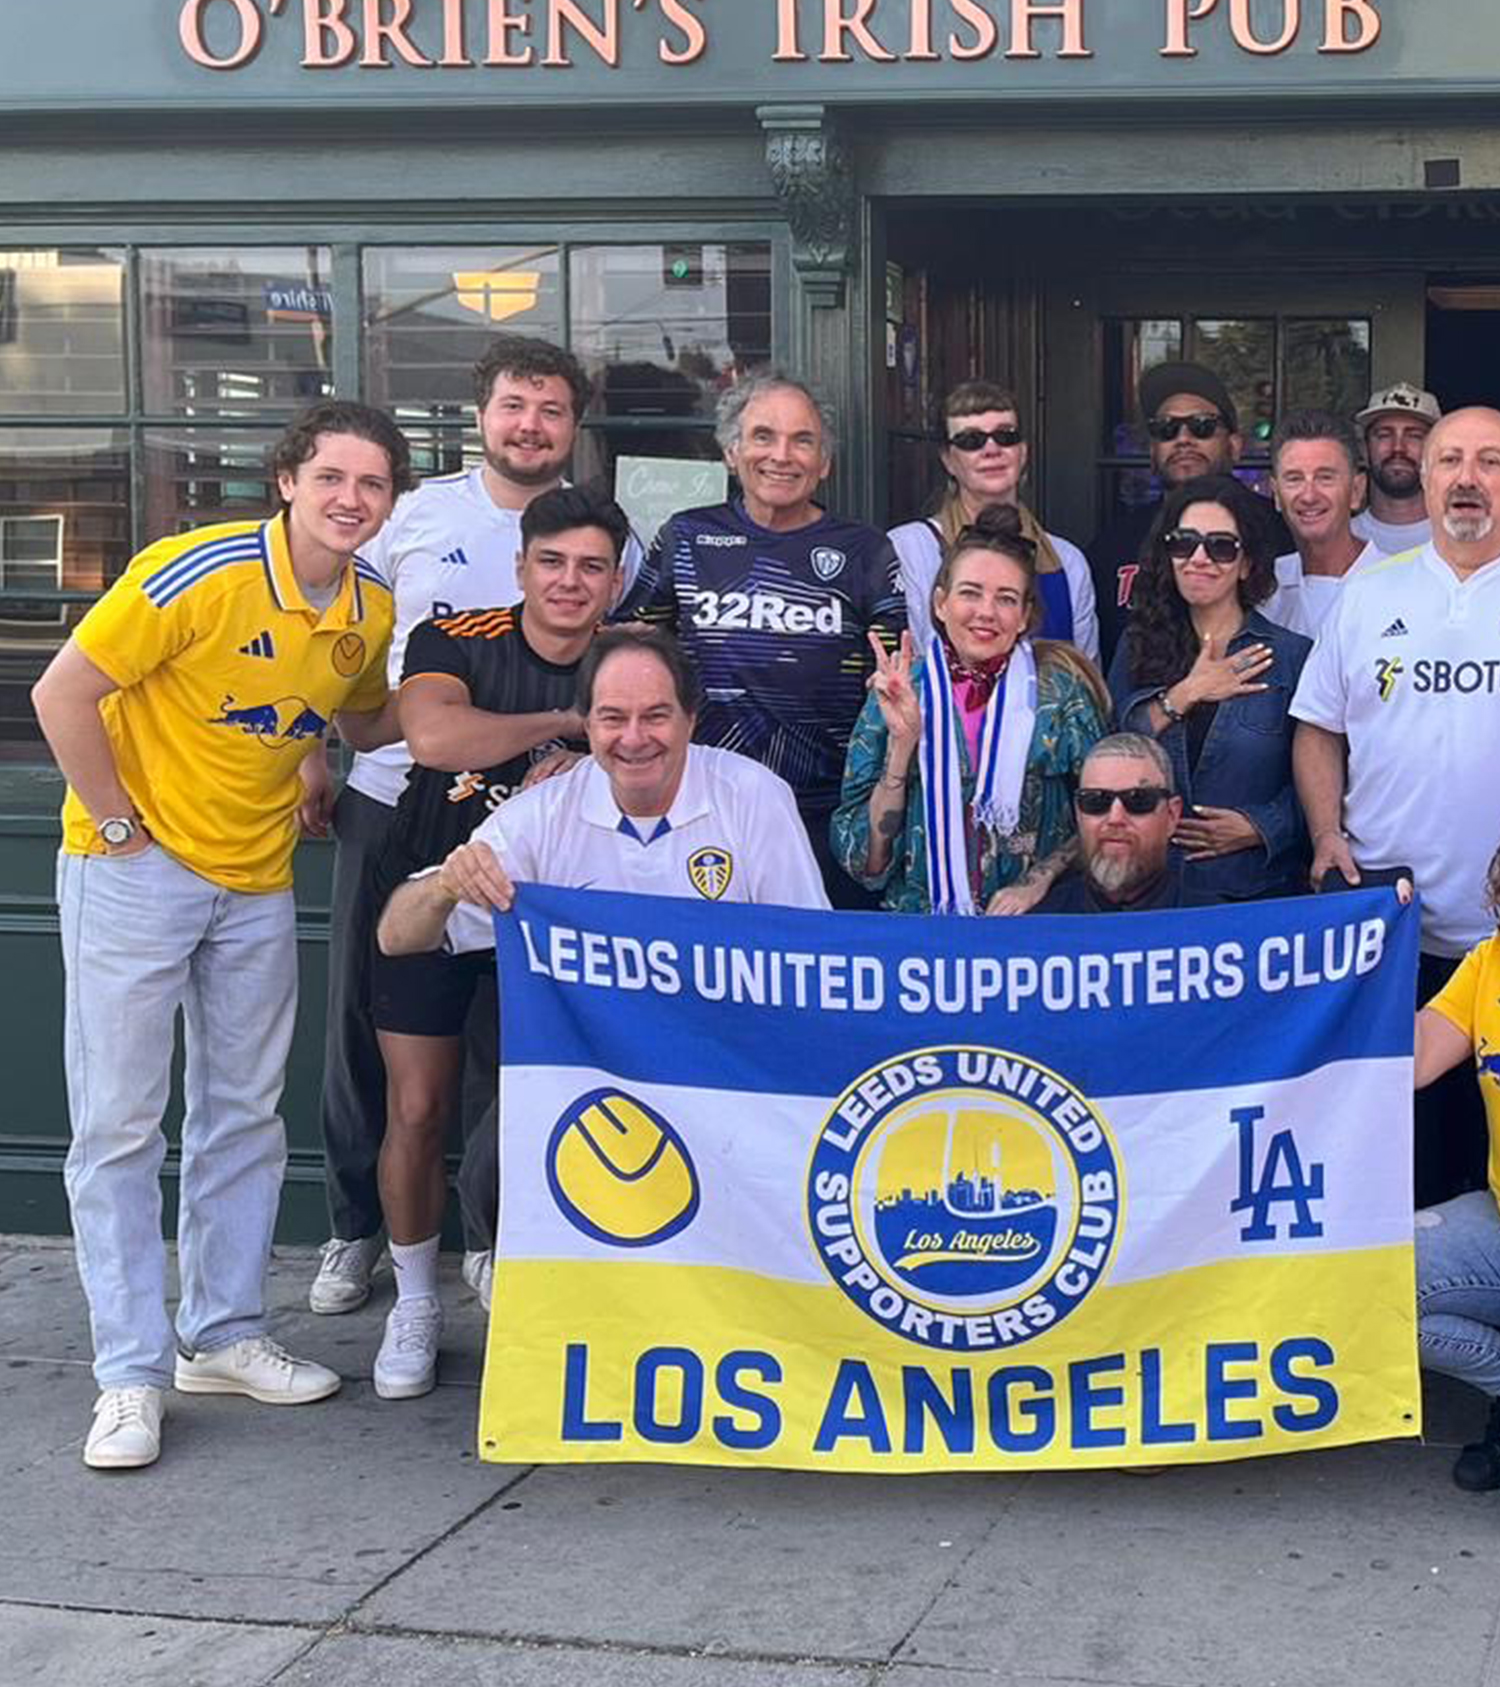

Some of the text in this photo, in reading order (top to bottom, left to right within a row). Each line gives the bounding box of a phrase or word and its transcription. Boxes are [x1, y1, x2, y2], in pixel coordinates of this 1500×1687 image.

[179, 0, 1381, 67] O'BRIEN'S IRISH PUB
[692, 591, 842, 634] 32Red
[520, 917, 1386, 1014] LEEDS UNITED SUPPORTERS CLUB
[822, 1052, 1103, 1153] LEEDS UNITED
[1230, 1106, 1324, 1242] LA
[815, 1170, 1115, 1347] SUPPORTERS CLUB
[904, 1229, 1035, 1256] Los Angeles
[561, 1337, 1339, 1453] LOS ANGELES
